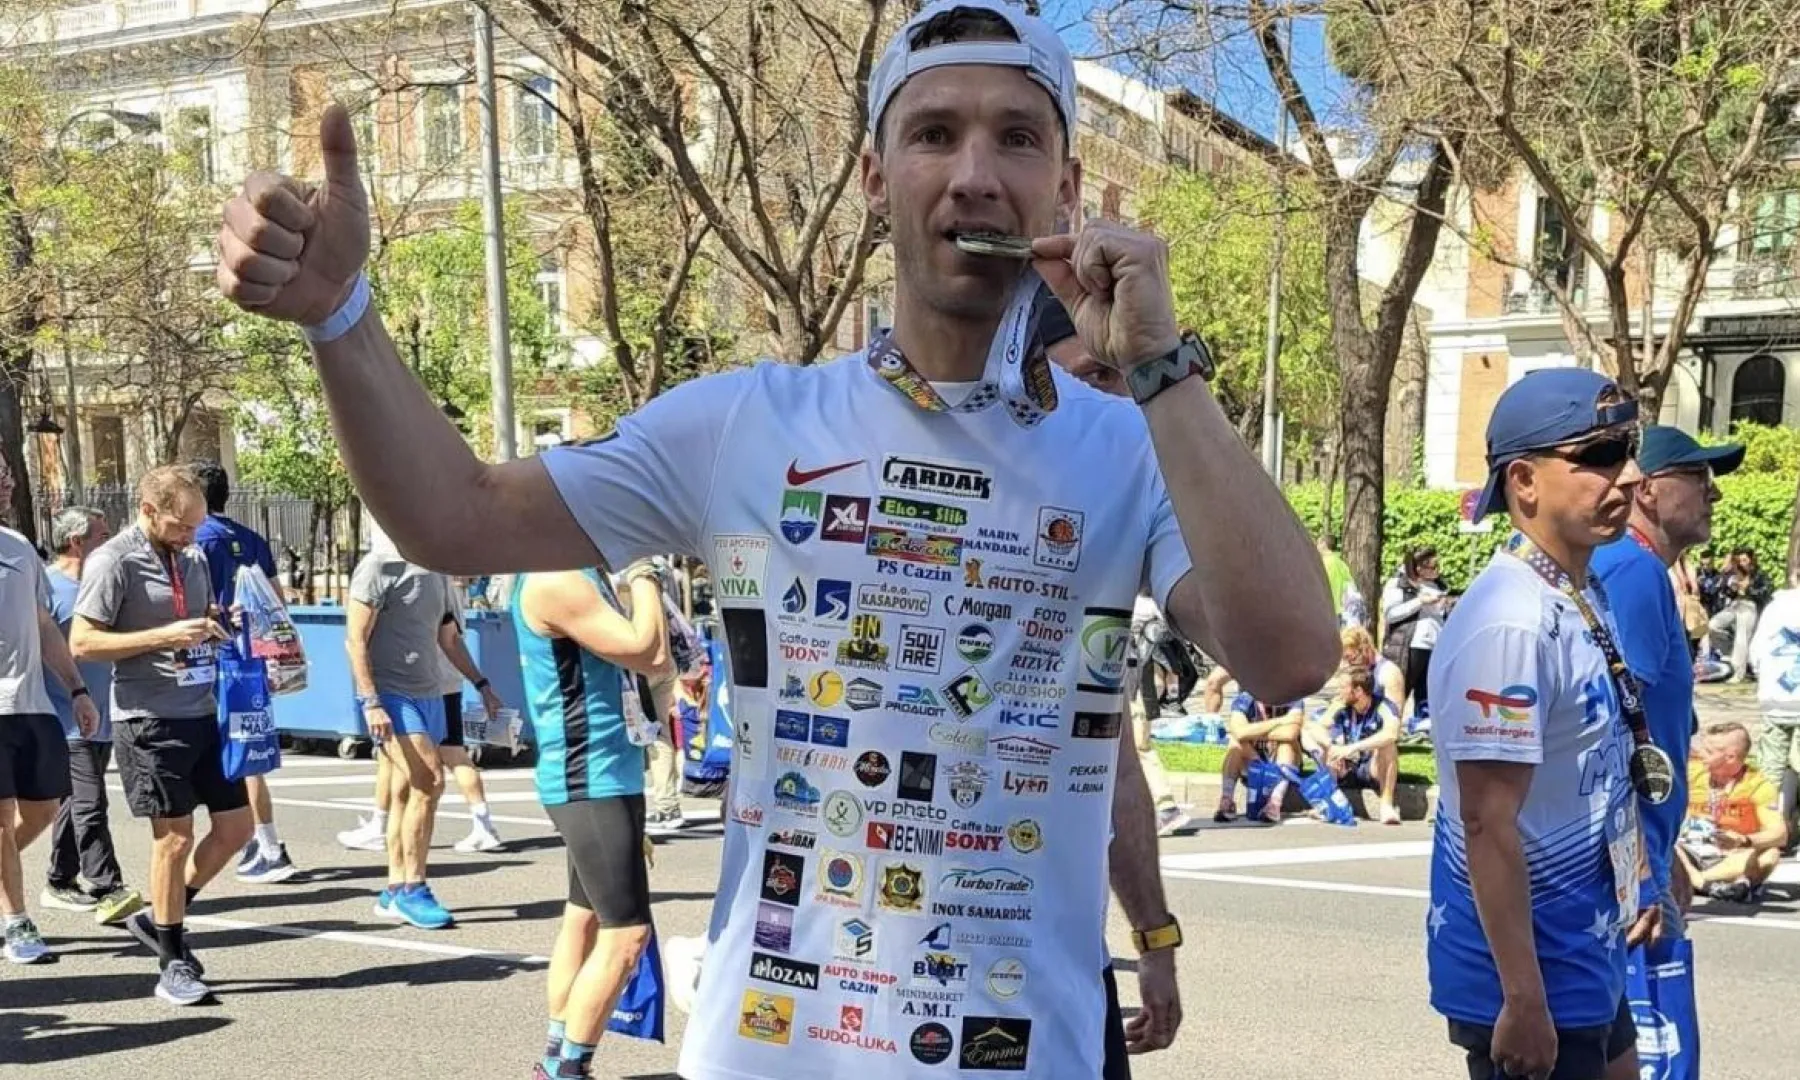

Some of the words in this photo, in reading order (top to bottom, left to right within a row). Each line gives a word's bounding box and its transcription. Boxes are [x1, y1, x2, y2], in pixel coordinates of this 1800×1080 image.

[884, 456, 991, 499] ČARDAK
[826, 502, 863, 531] XL
[885, 500, 918, 517] Eko
[977, 527, 1020, 542] MARIN
[964, 539, 1030, 557] MANDARIĆ
[877, 559, 898, 576] PS
[902, 562, 953, 583] Cazin
[720, 577, 760, 597] VIVA
[988, 573, 1070, 602] AUTO-STIL
[958, 599, 1013, 621] Morgan
[1034, 605, 1068, 624] FOTO
[905, 631, 940, 650] SQU
[902, 648, 937, 668] ARE
[993, 680, 1027, 696] GOLD
[1030, 683, 1067, 700] SHOP
[885, 700, 947, 718] PROAUDIT
[999, 709, 1060, 728] IKIĆ
[864, 800, 888, 818] vp
[951, 819, 982, 834] Caffe
[985, 825, 1004, 834] bar
[895, 824, 944, 856] BENIMI
[945, 831, 1004, 852] SONY
[952, 877, 1030, 892] TurboTrade
[931, 902, 965, 917] INOX
[968, 905, 1032, 921] SAMARDŽIĆ
[823, 963, 857, 979] AUTO
[861, 969, 898, 986] SHOP
[839, 979, 878, 996] CAZIN
[896, 987, 964, 1003] MINIMARKET
[902, 1000, 957, 1019] A.M.I.
[806, 1026, 897, 1055] SUDO-LUKA
